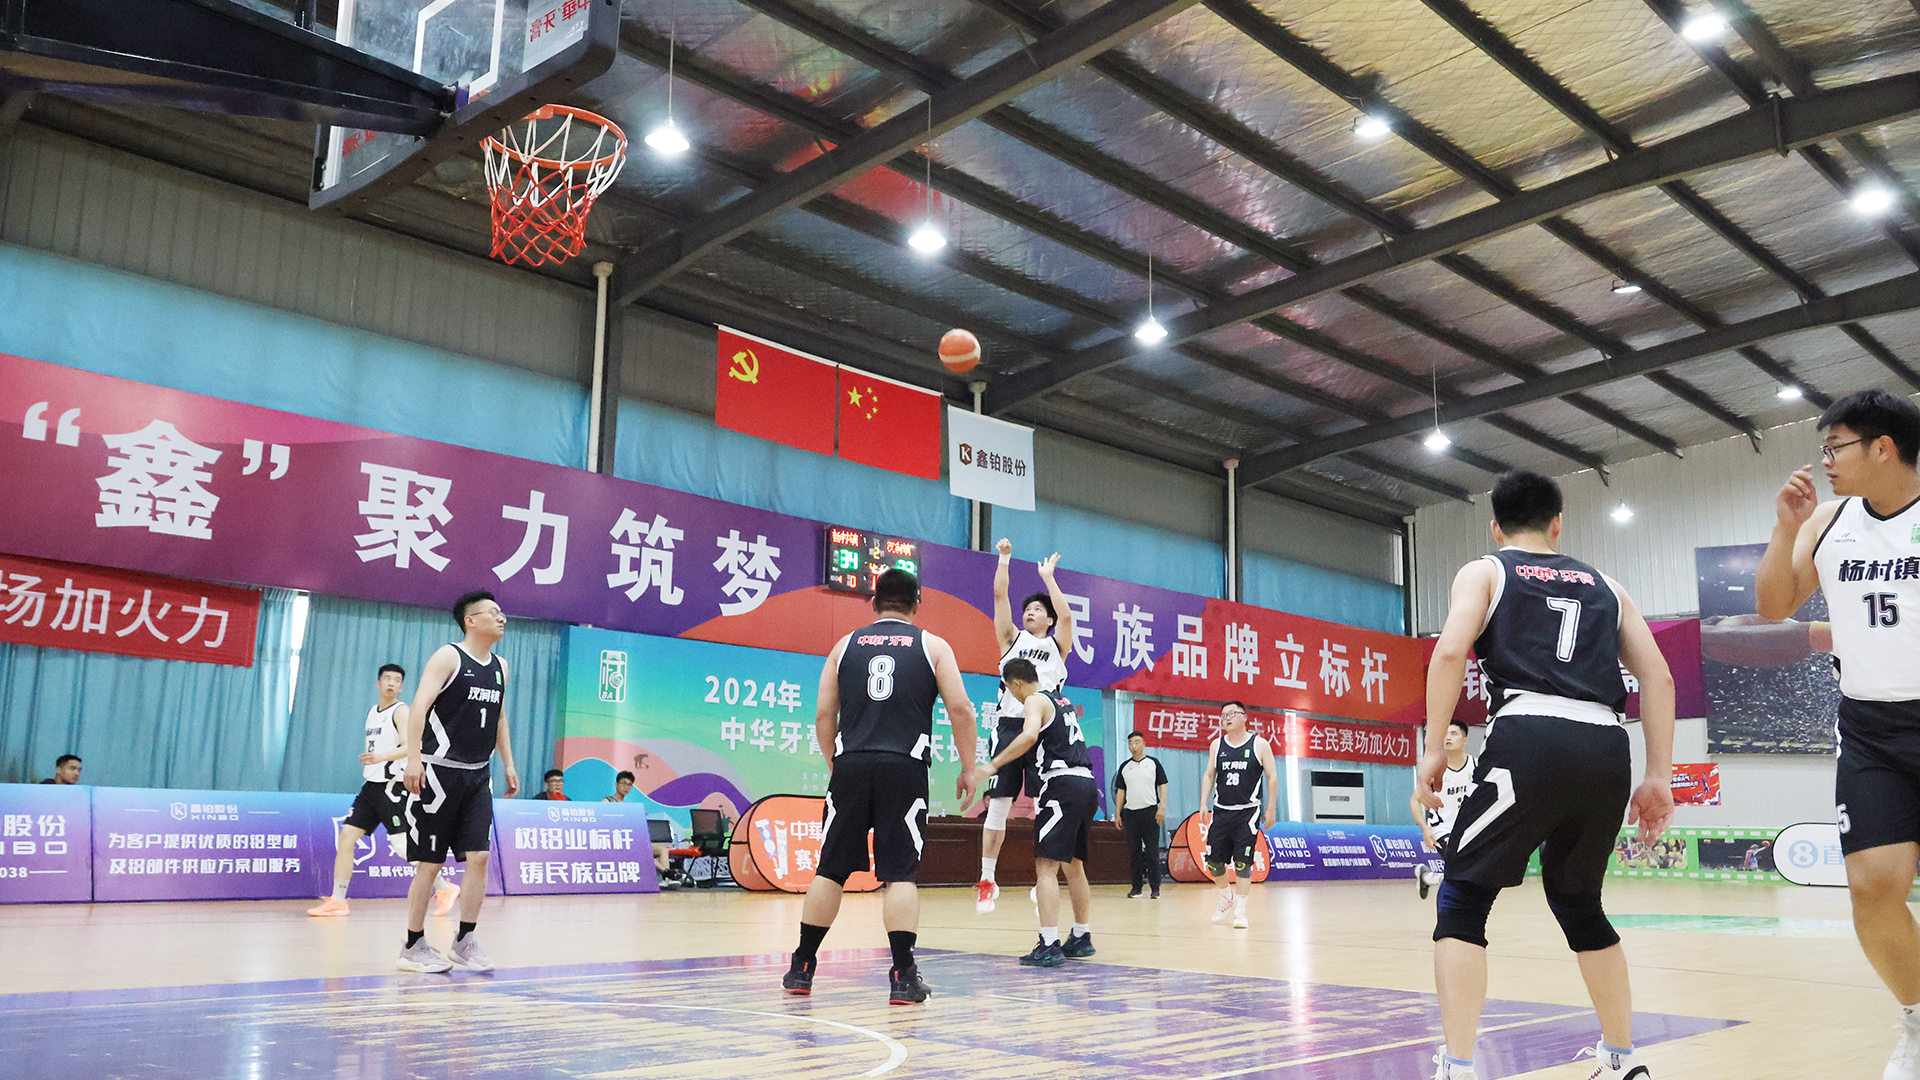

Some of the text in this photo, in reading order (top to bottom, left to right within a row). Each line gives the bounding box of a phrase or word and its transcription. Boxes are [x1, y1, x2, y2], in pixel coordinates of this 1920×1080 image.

[976, 449, 1027, 477] 鑫铂股份
[839, 548, 859, 570] 34
[1838, 556, 1920, 582] 杨村镇
[0, 569, 229, 648] 场加火力
[1862, 592, 1900, 628] 15
[1546, 597, 1581, 662] 7
[1063, 593, 1389, 705] 民族品牌立标杆
[867, 655, 896, 701] 8
[704, 676, 802, 713] 2024年
[480, 707, 487, 728] 1
[1309, 724, 1410, 758] 全民赛场加火力
[3, 814, 66, 837] 股份
[108, 833, 298, 849] 为客户提供优质的铝型材
[429, 834, 437, 852] 1
[515, 828, 634, 850] 树铝业标杆
[1277, 850, 1312, 858] XINBO
[1389, 850, 1417, 858] XINBO
[0, 867, 28, 878] 038
[109, 858, 301, 874] 及铝部件供应方案和服务
[520, 861, 641, 884] 铸民族品牌
